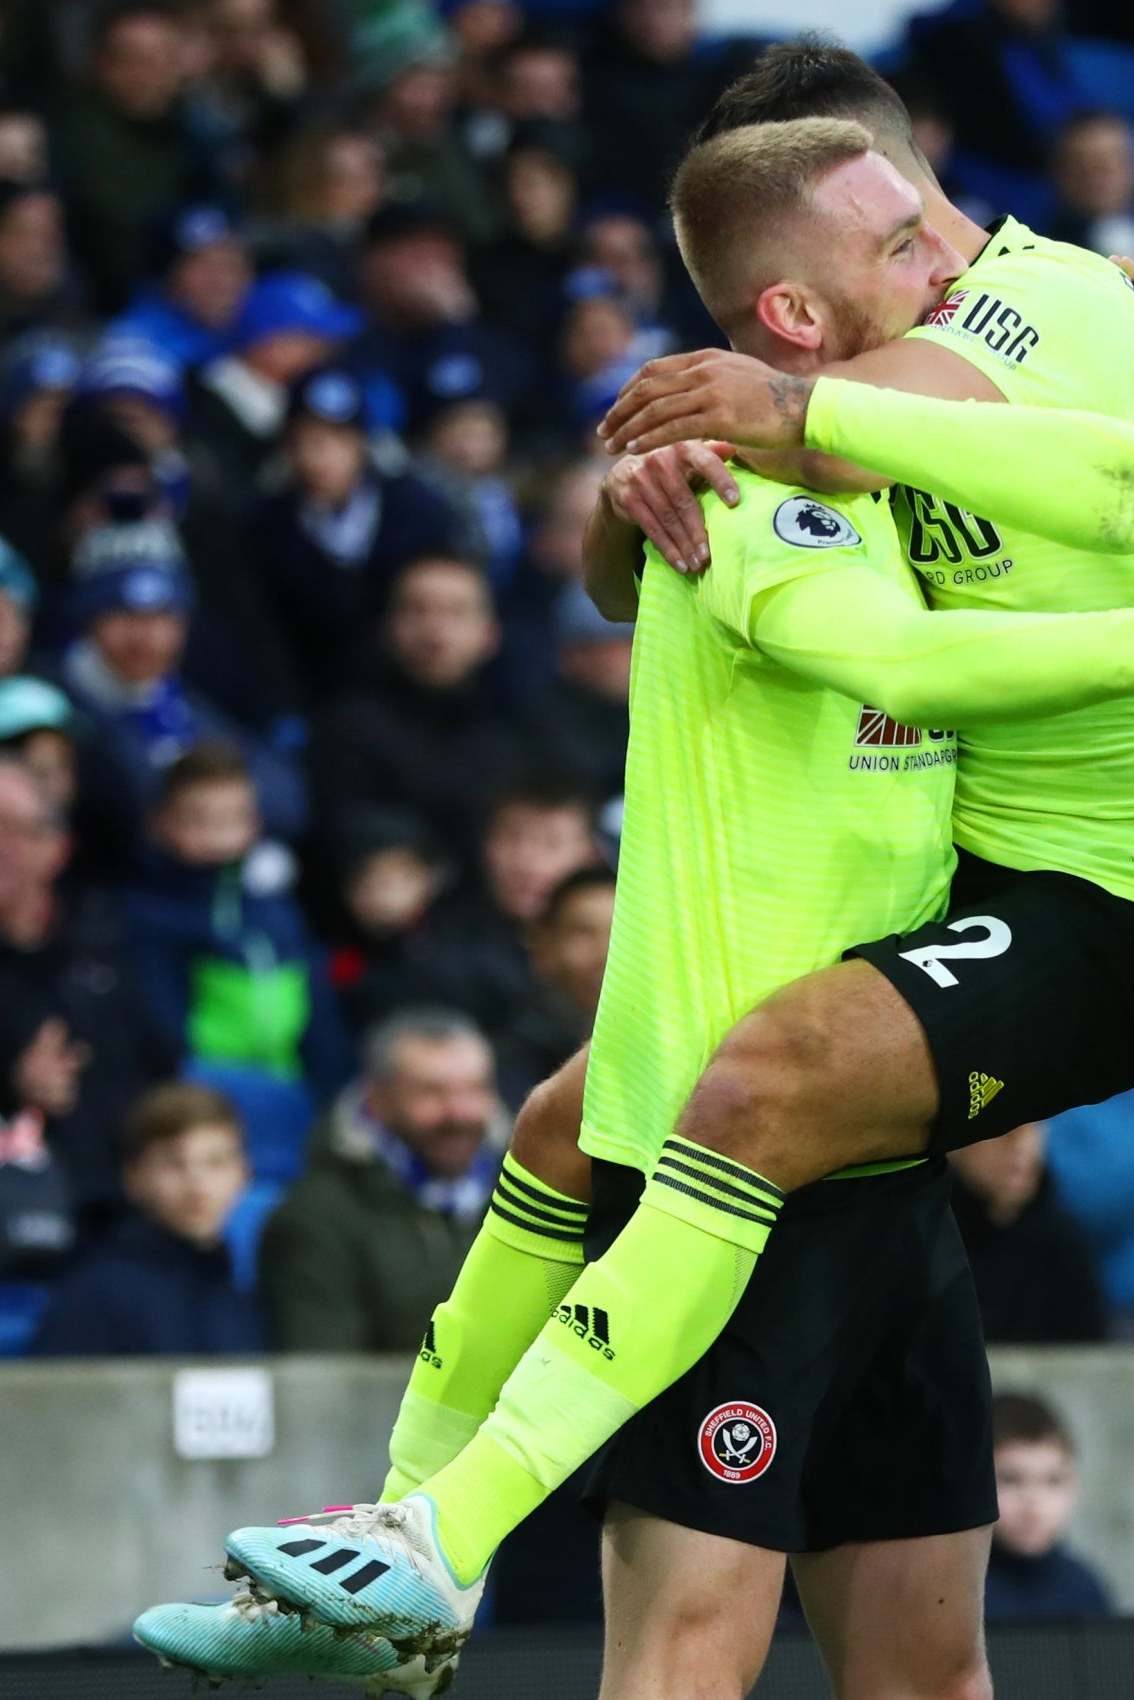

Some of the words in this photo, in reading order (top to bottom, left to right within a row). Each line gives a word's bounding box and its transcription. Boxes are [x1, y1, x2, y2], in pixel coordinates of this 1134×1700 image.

[962, 293, 1039, 363] USG
[953, 559, 1013, 585] GROUP
[849, 755, 899, 771] UNION
[898, 915, 1012, 989] 2
[705, 1408, 743, 1437] SHEFFIELD
[745, 1410, 769, 1434] UNITED
